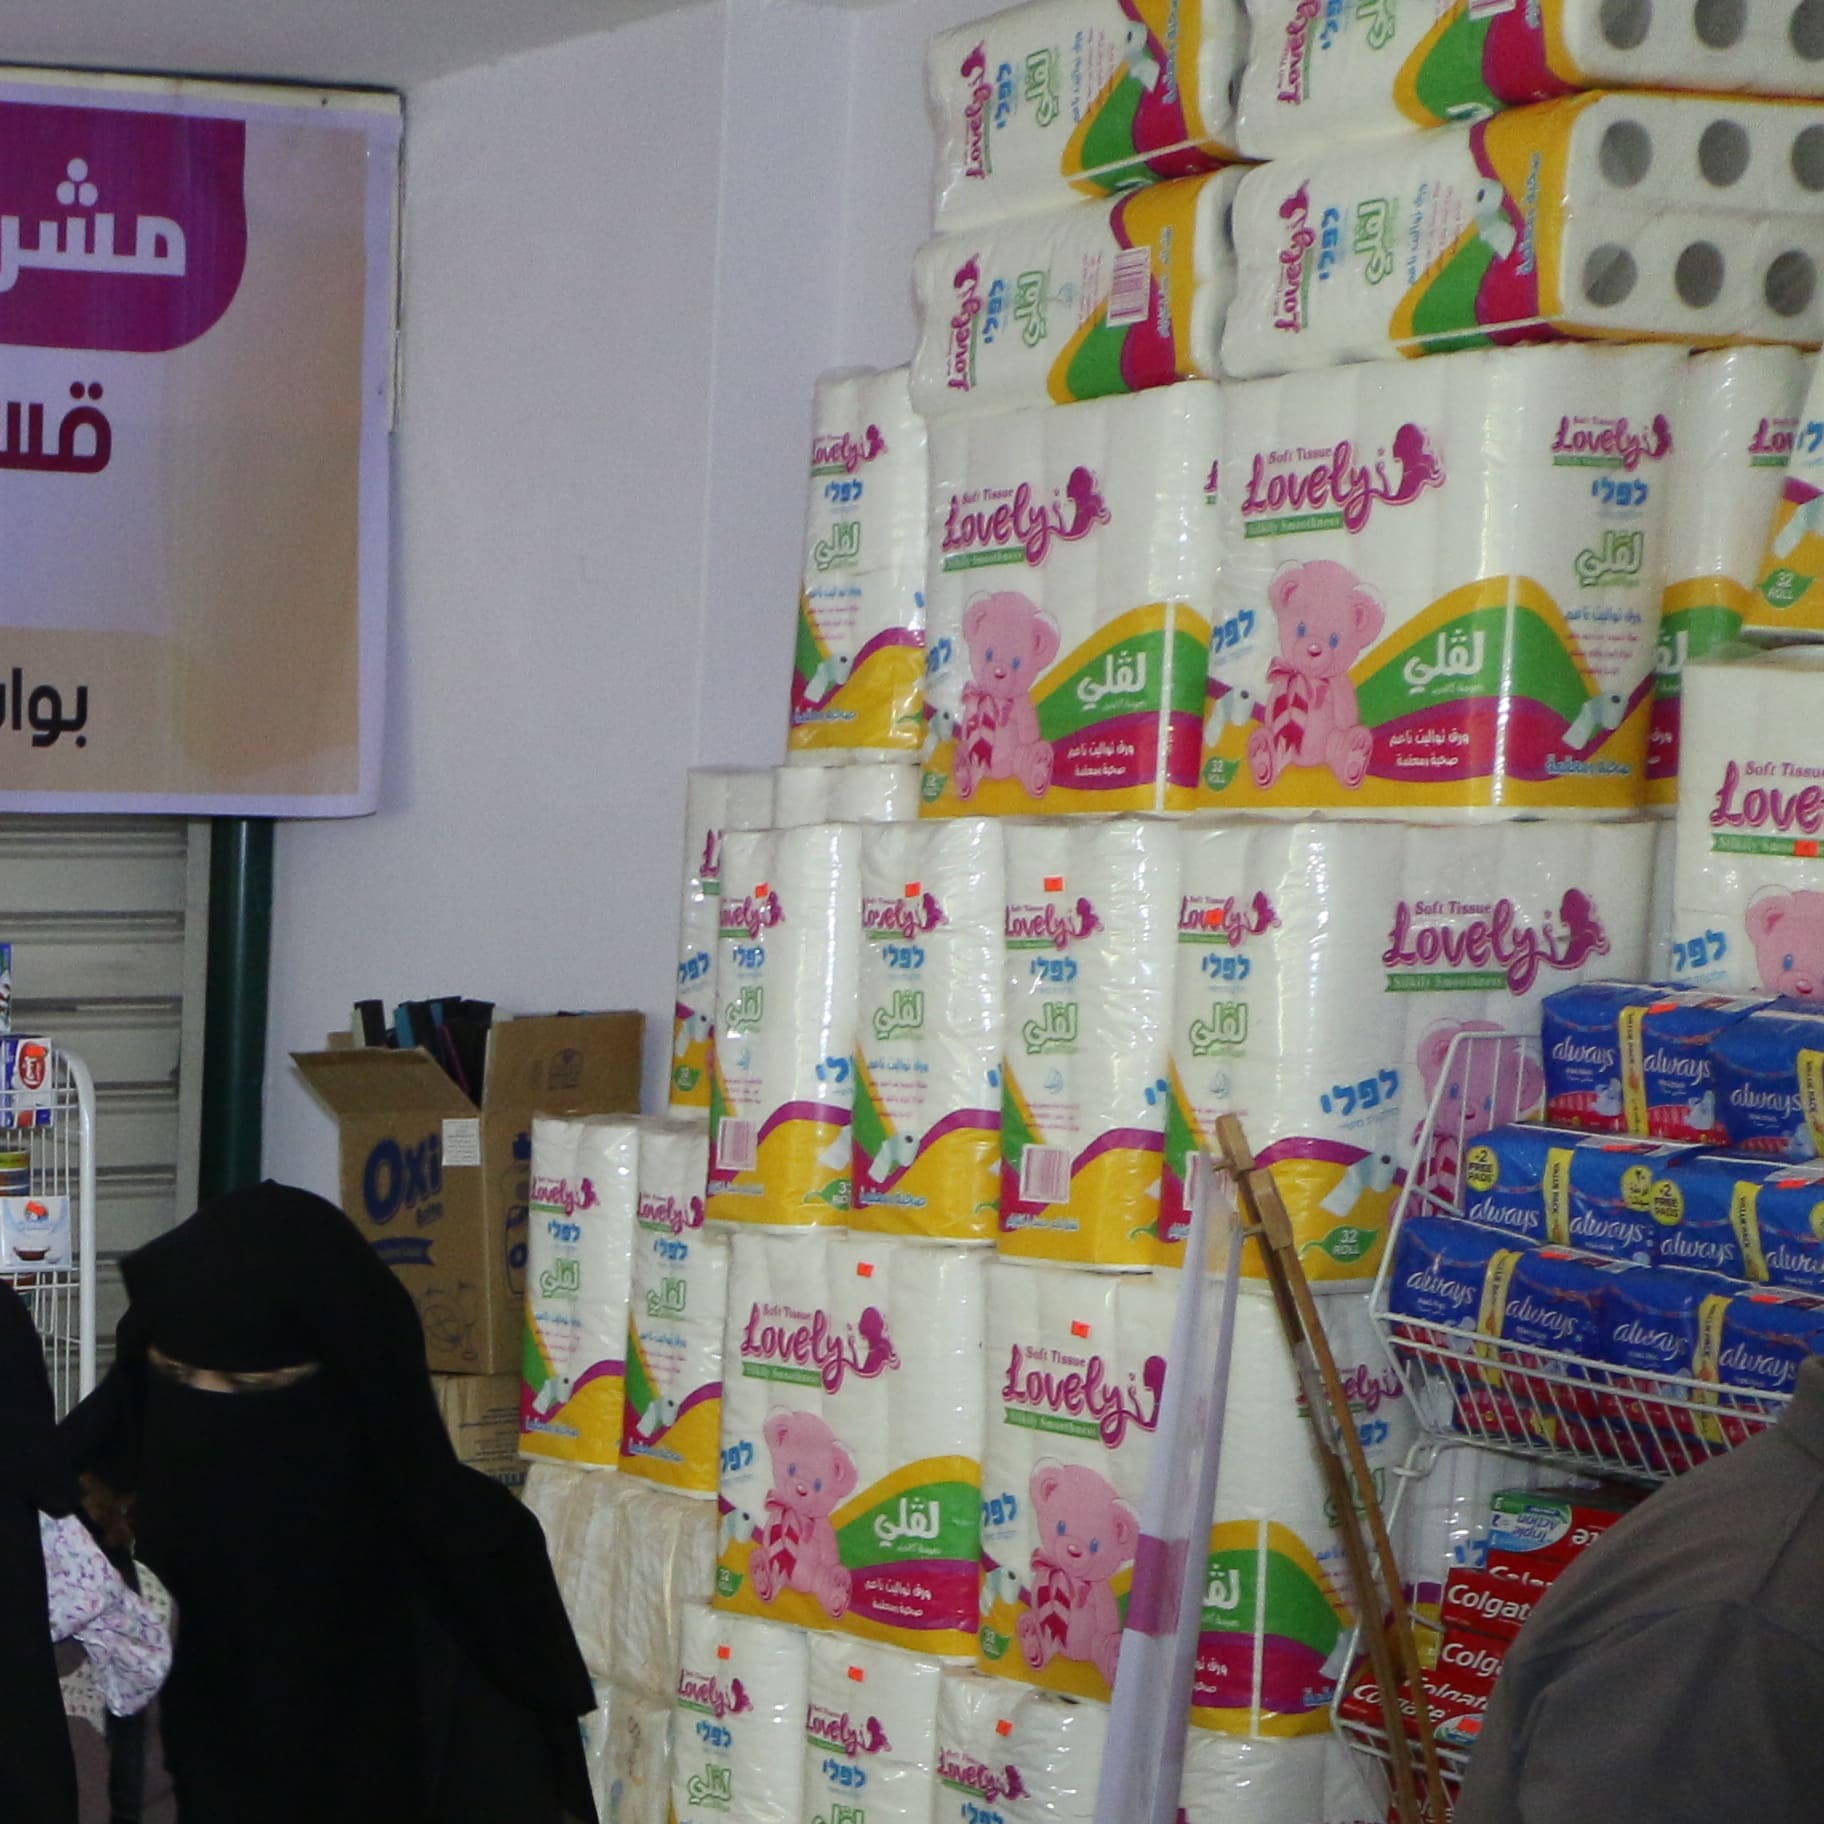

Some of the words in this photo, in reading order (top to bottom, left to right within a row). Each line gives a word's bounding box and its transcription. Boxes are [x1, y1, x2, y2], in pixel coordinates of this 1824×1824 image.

[1242, 440, 1374, 534] Lovely
[941, 482, 1051, 568] Lovely
[1745, 760, 1776, 776] Soft
[1415, 900, 1443, 915] Soft
[1448, 900, 1492, 915] Tissue
[1382, 898, 1540, 996] Lovely
[1552, 1034, 1615, 1074] always
[1643, 1047, 1712, 1087] always
[1319, 1068, 1401, 1118] לפלי
[1730, 1085, 1802, 1120] always
[1341, 1228, 1358, 1244] 32
[1469, 1196, 1540, 1237] always
[1569, 1204, 1644, 1247] always
[1661, 1236, 1736, 1267] always
[1405, 1270, 1476, 1308] always
[1505, 1297, 1579, 1338] always
[740, 1302, 845, 1395] Lovely
[1051, 1349, 1087, 1369] Tissue
[1613, 1321, 1688, 1361] always
[1719, 1343, 1796, 1383] always
[1001, 1343, 1125, 1450] Lovely
